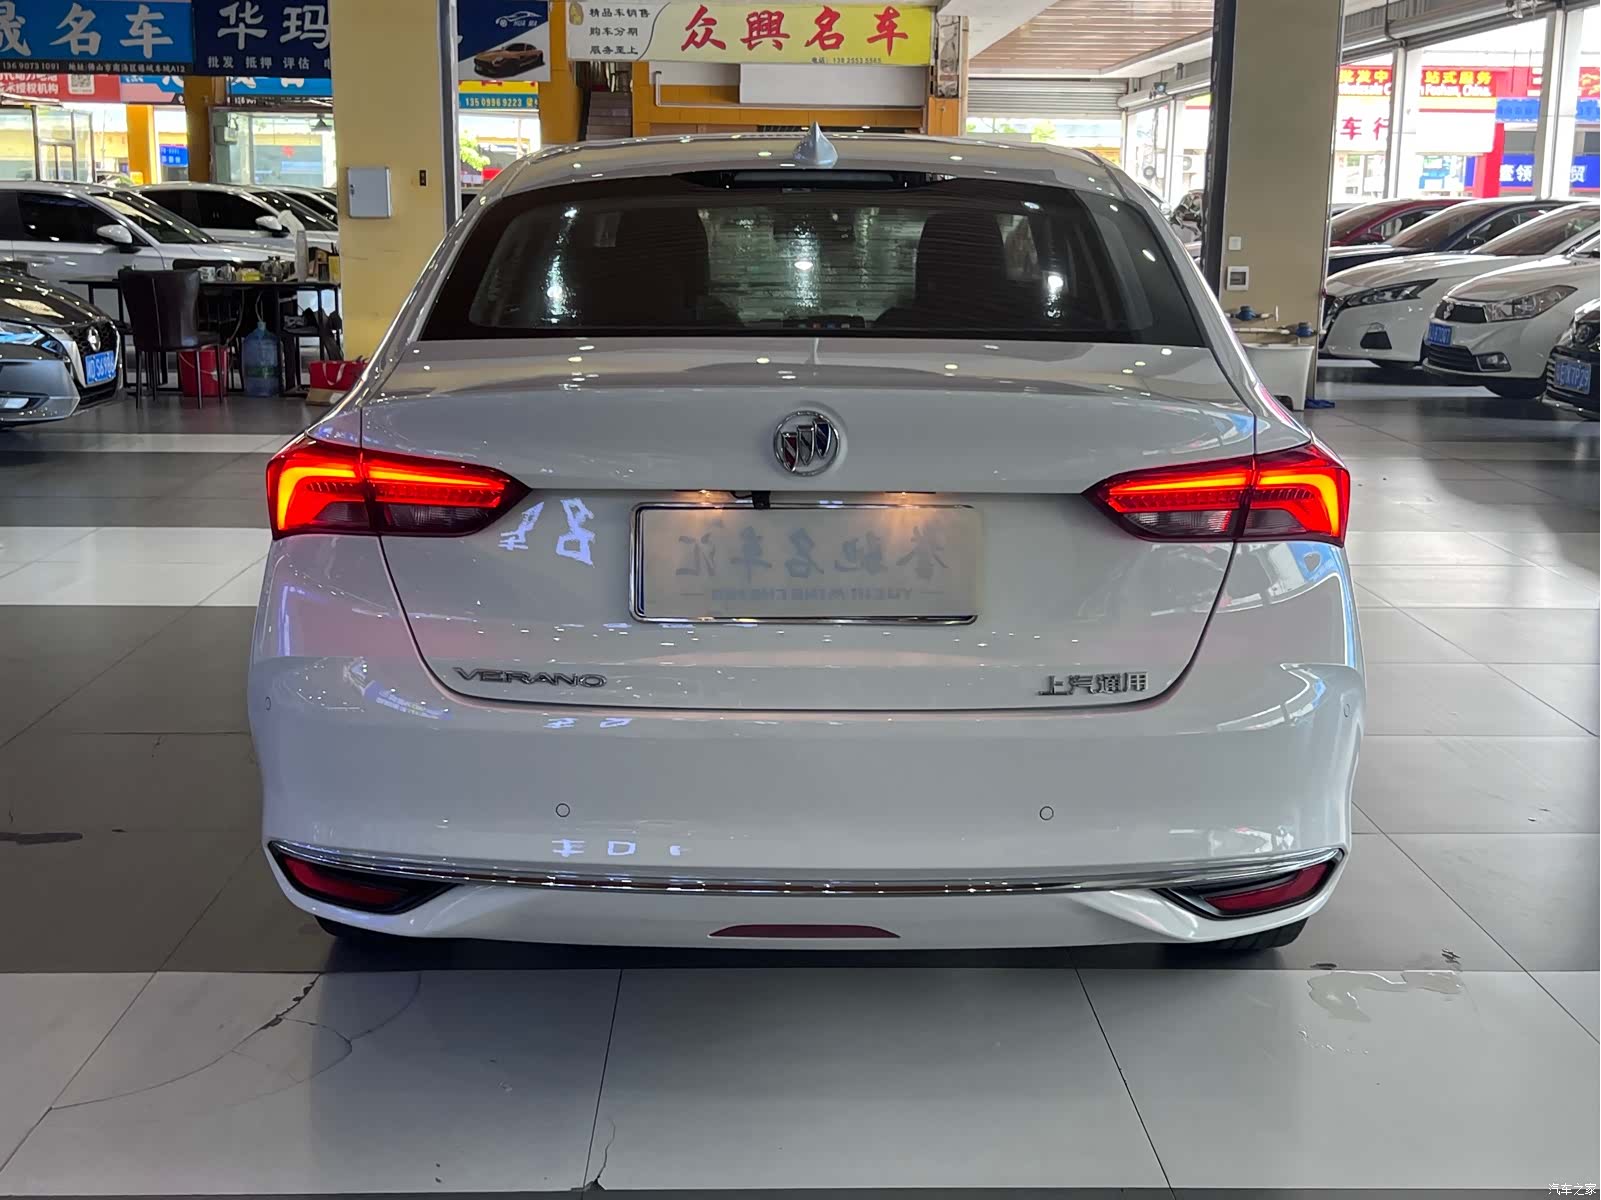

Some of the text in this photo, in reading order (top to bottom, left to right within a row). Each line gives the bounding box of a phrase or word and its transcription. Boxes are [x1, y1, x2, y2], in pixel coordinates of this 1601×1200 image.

[452, 667, 608, 688] VERANO
[1036, 671, 1149, 696] 上汽通用
